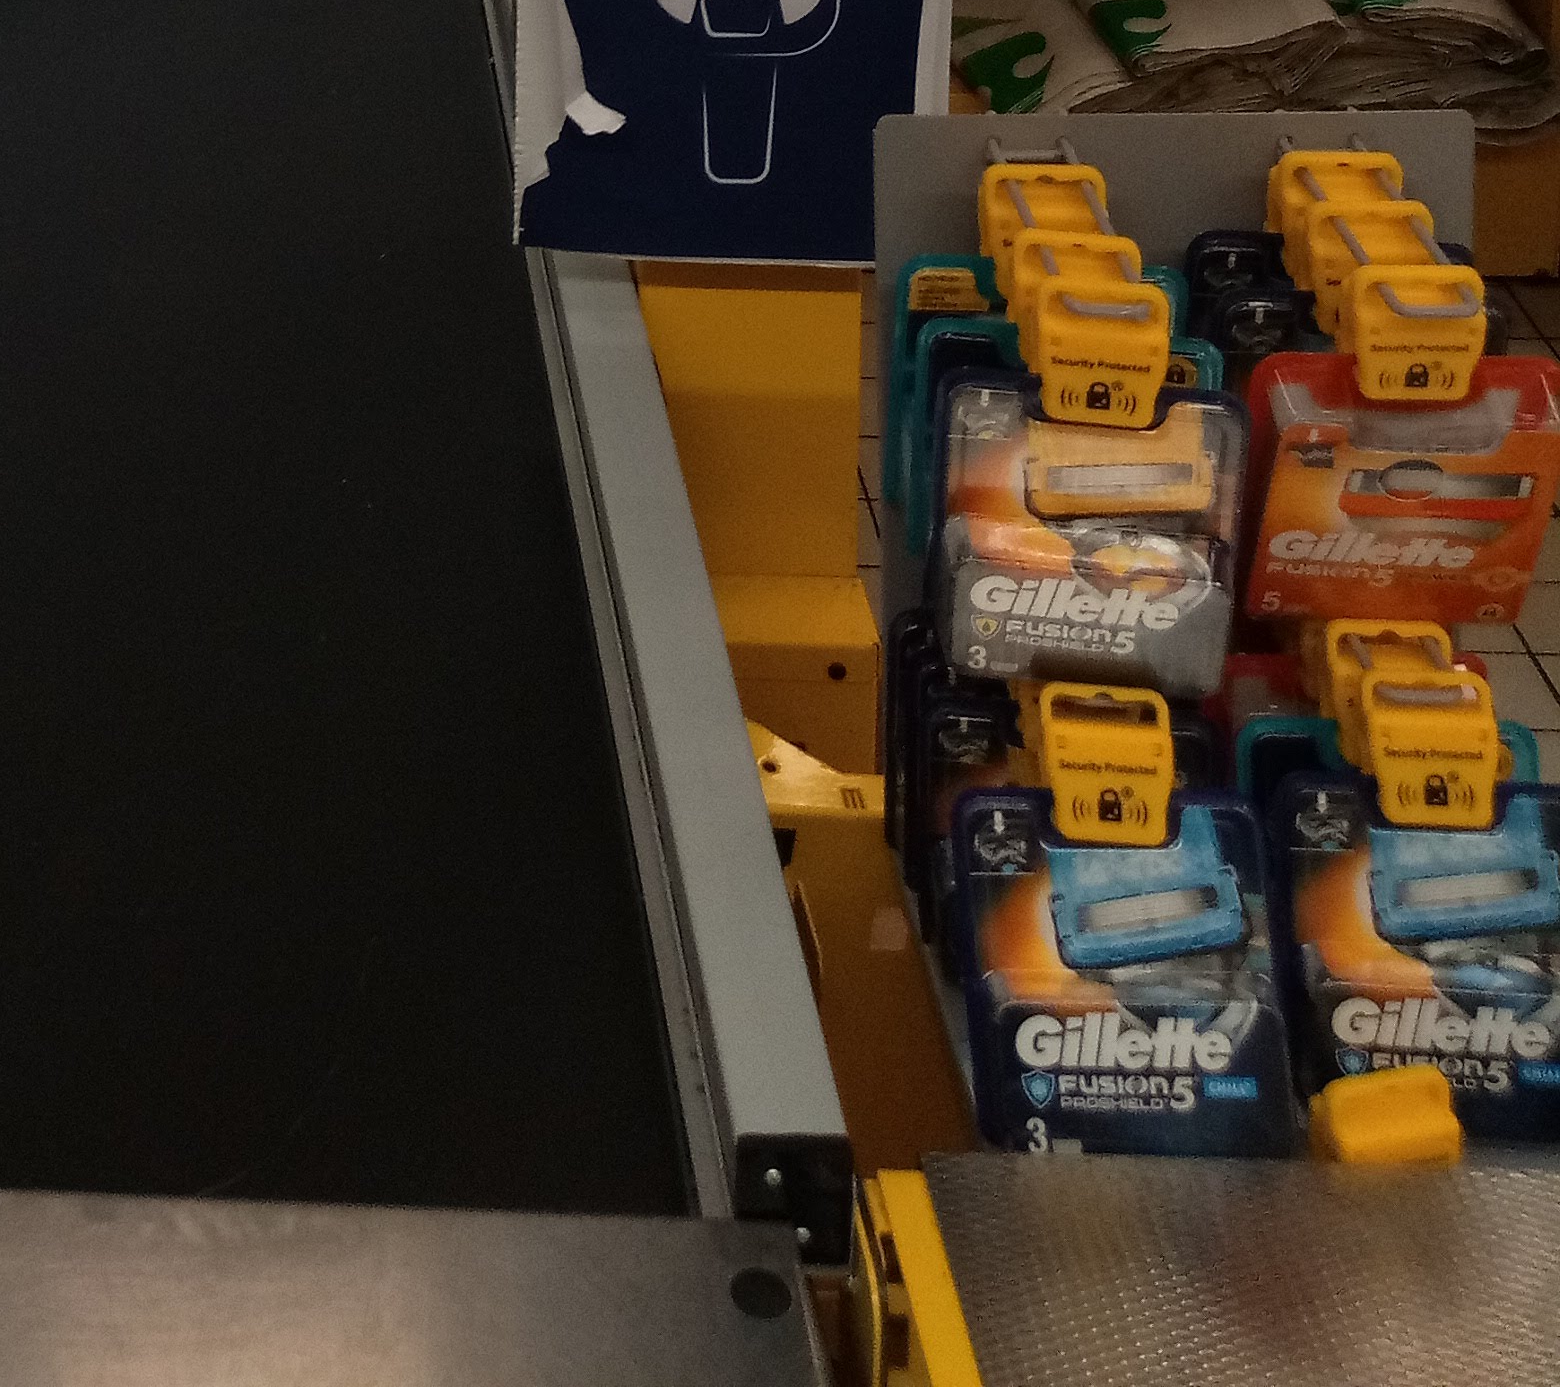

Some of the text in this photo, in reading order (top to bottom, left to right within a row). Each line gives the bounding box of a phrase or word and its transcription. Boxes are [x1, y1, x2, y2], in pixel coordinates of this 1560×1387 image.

[1268, 530, 1475, 568] Gillette
[969, 574, 1180, 630] Gillette
[967, 644, 987, 670] 3
[1015, 1012, 1233, 1071] Gillette
[1331, 996, 1551, 1059] Gillette
[1025, 1115, 1049, 1153] 3
